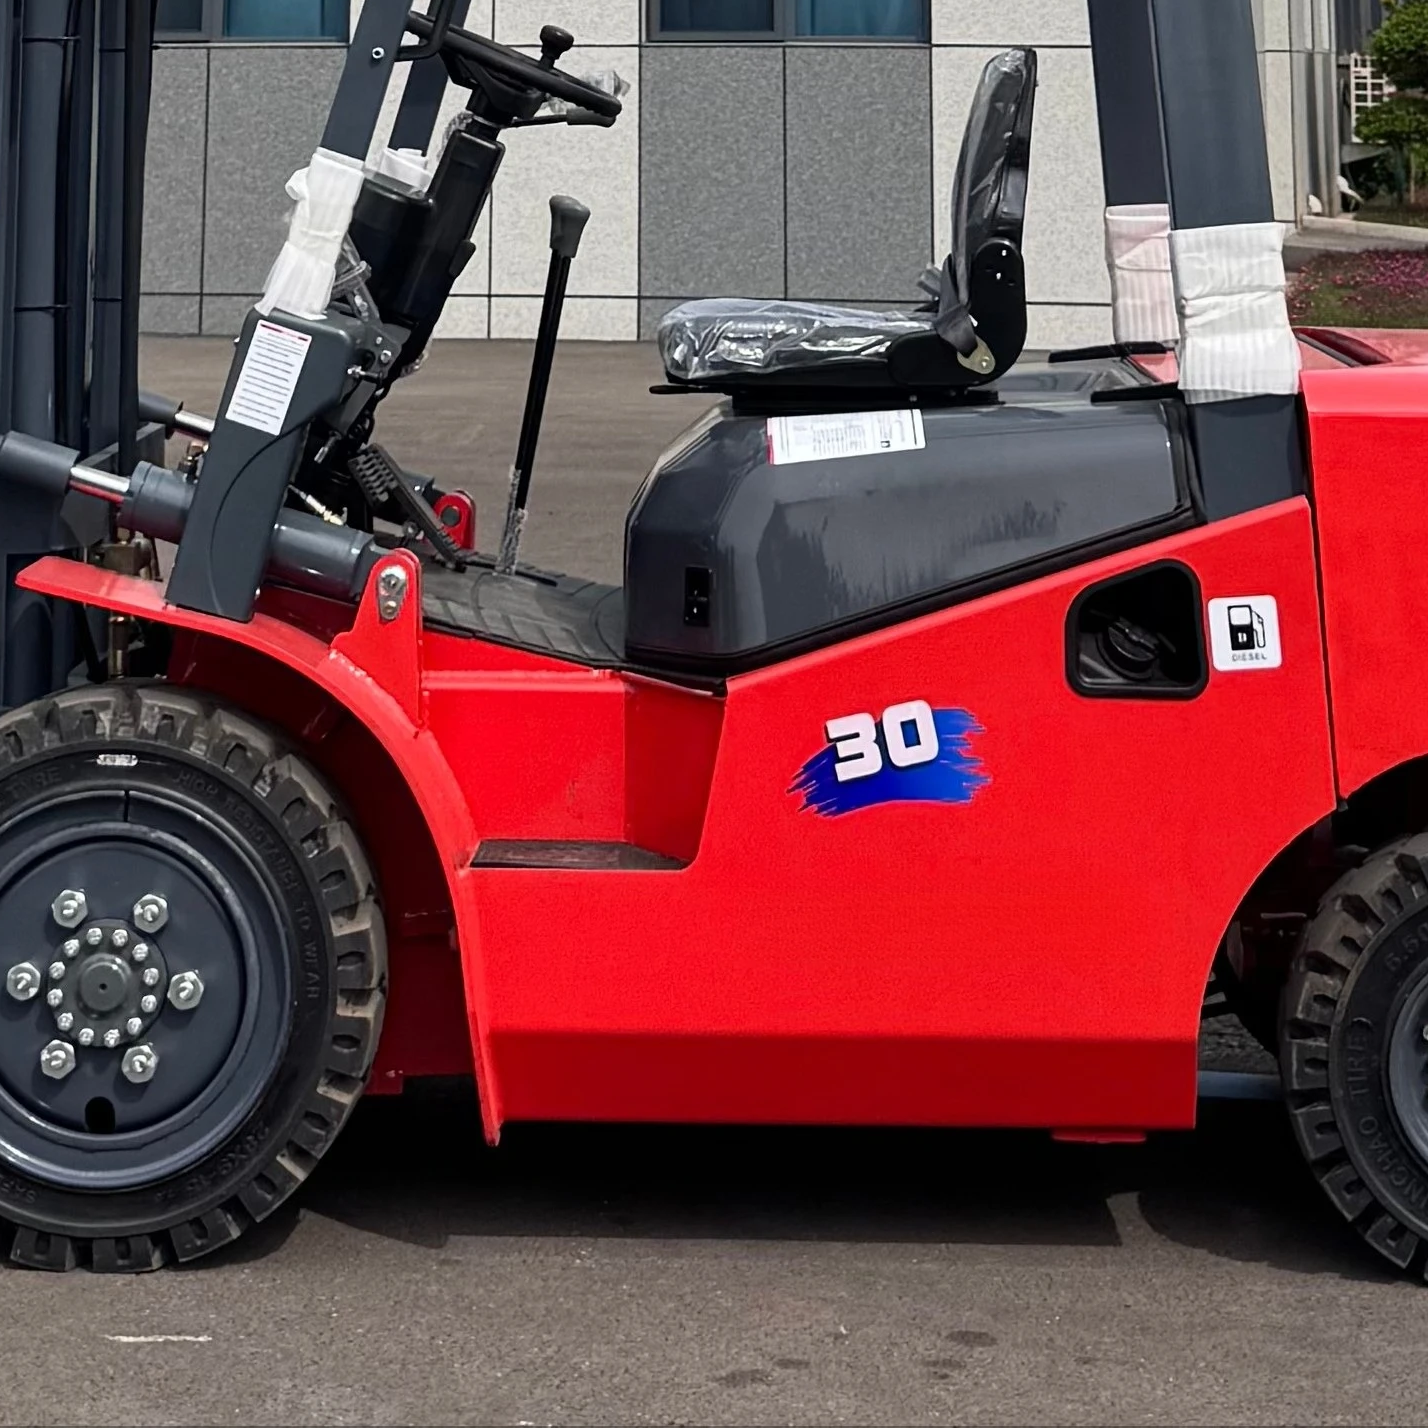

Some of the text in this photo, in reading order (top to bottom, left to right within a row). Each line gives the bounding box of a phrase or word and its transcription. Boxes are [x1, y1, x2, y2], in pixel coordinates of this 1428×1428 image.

[1231, 652, 1268, 662] DIESEL
[825, 699, 939, 783] 30
[301, 940, 320, 998] WEAR
[1347, 1030, 1371, 1100] TIRE
